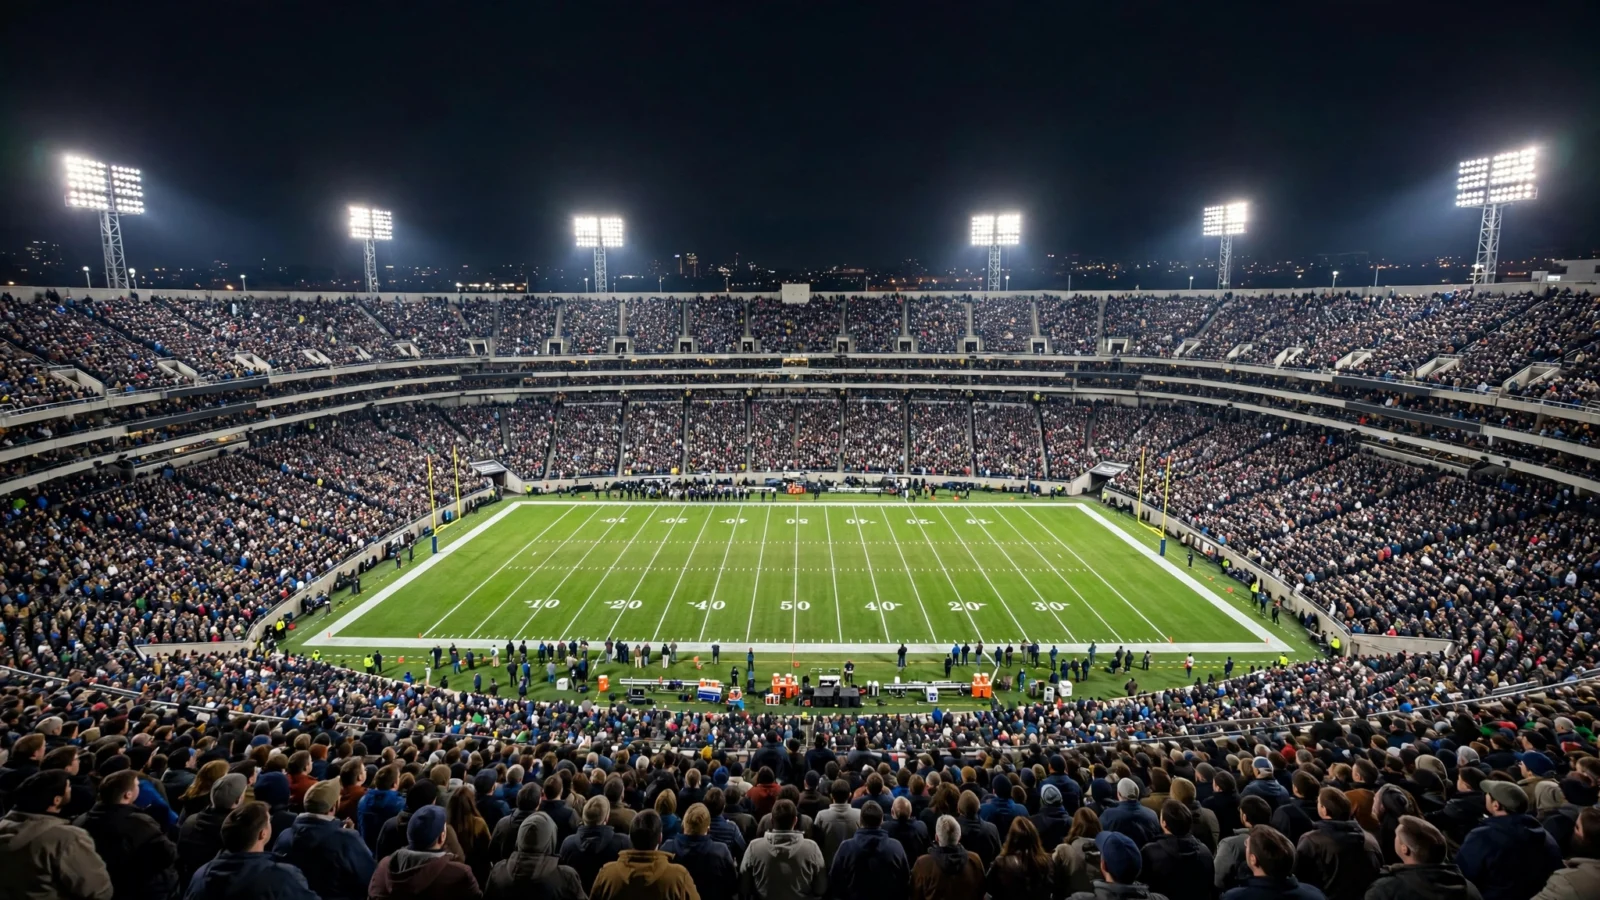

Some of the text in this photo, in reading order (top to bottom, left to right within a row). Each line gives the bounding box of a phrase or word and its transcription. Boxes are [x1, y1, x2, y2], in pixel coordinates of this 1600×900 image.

[528, 599, 560, 609] 10
[609, 599, 642, 609] 20
[694, 600, 726, 610] 40
[780, 600, 810, 610] 50
[864, 601, 895, 611] 40
[947, 601, 979, 611] 20
[1031, 601, 1063, 611] 30
